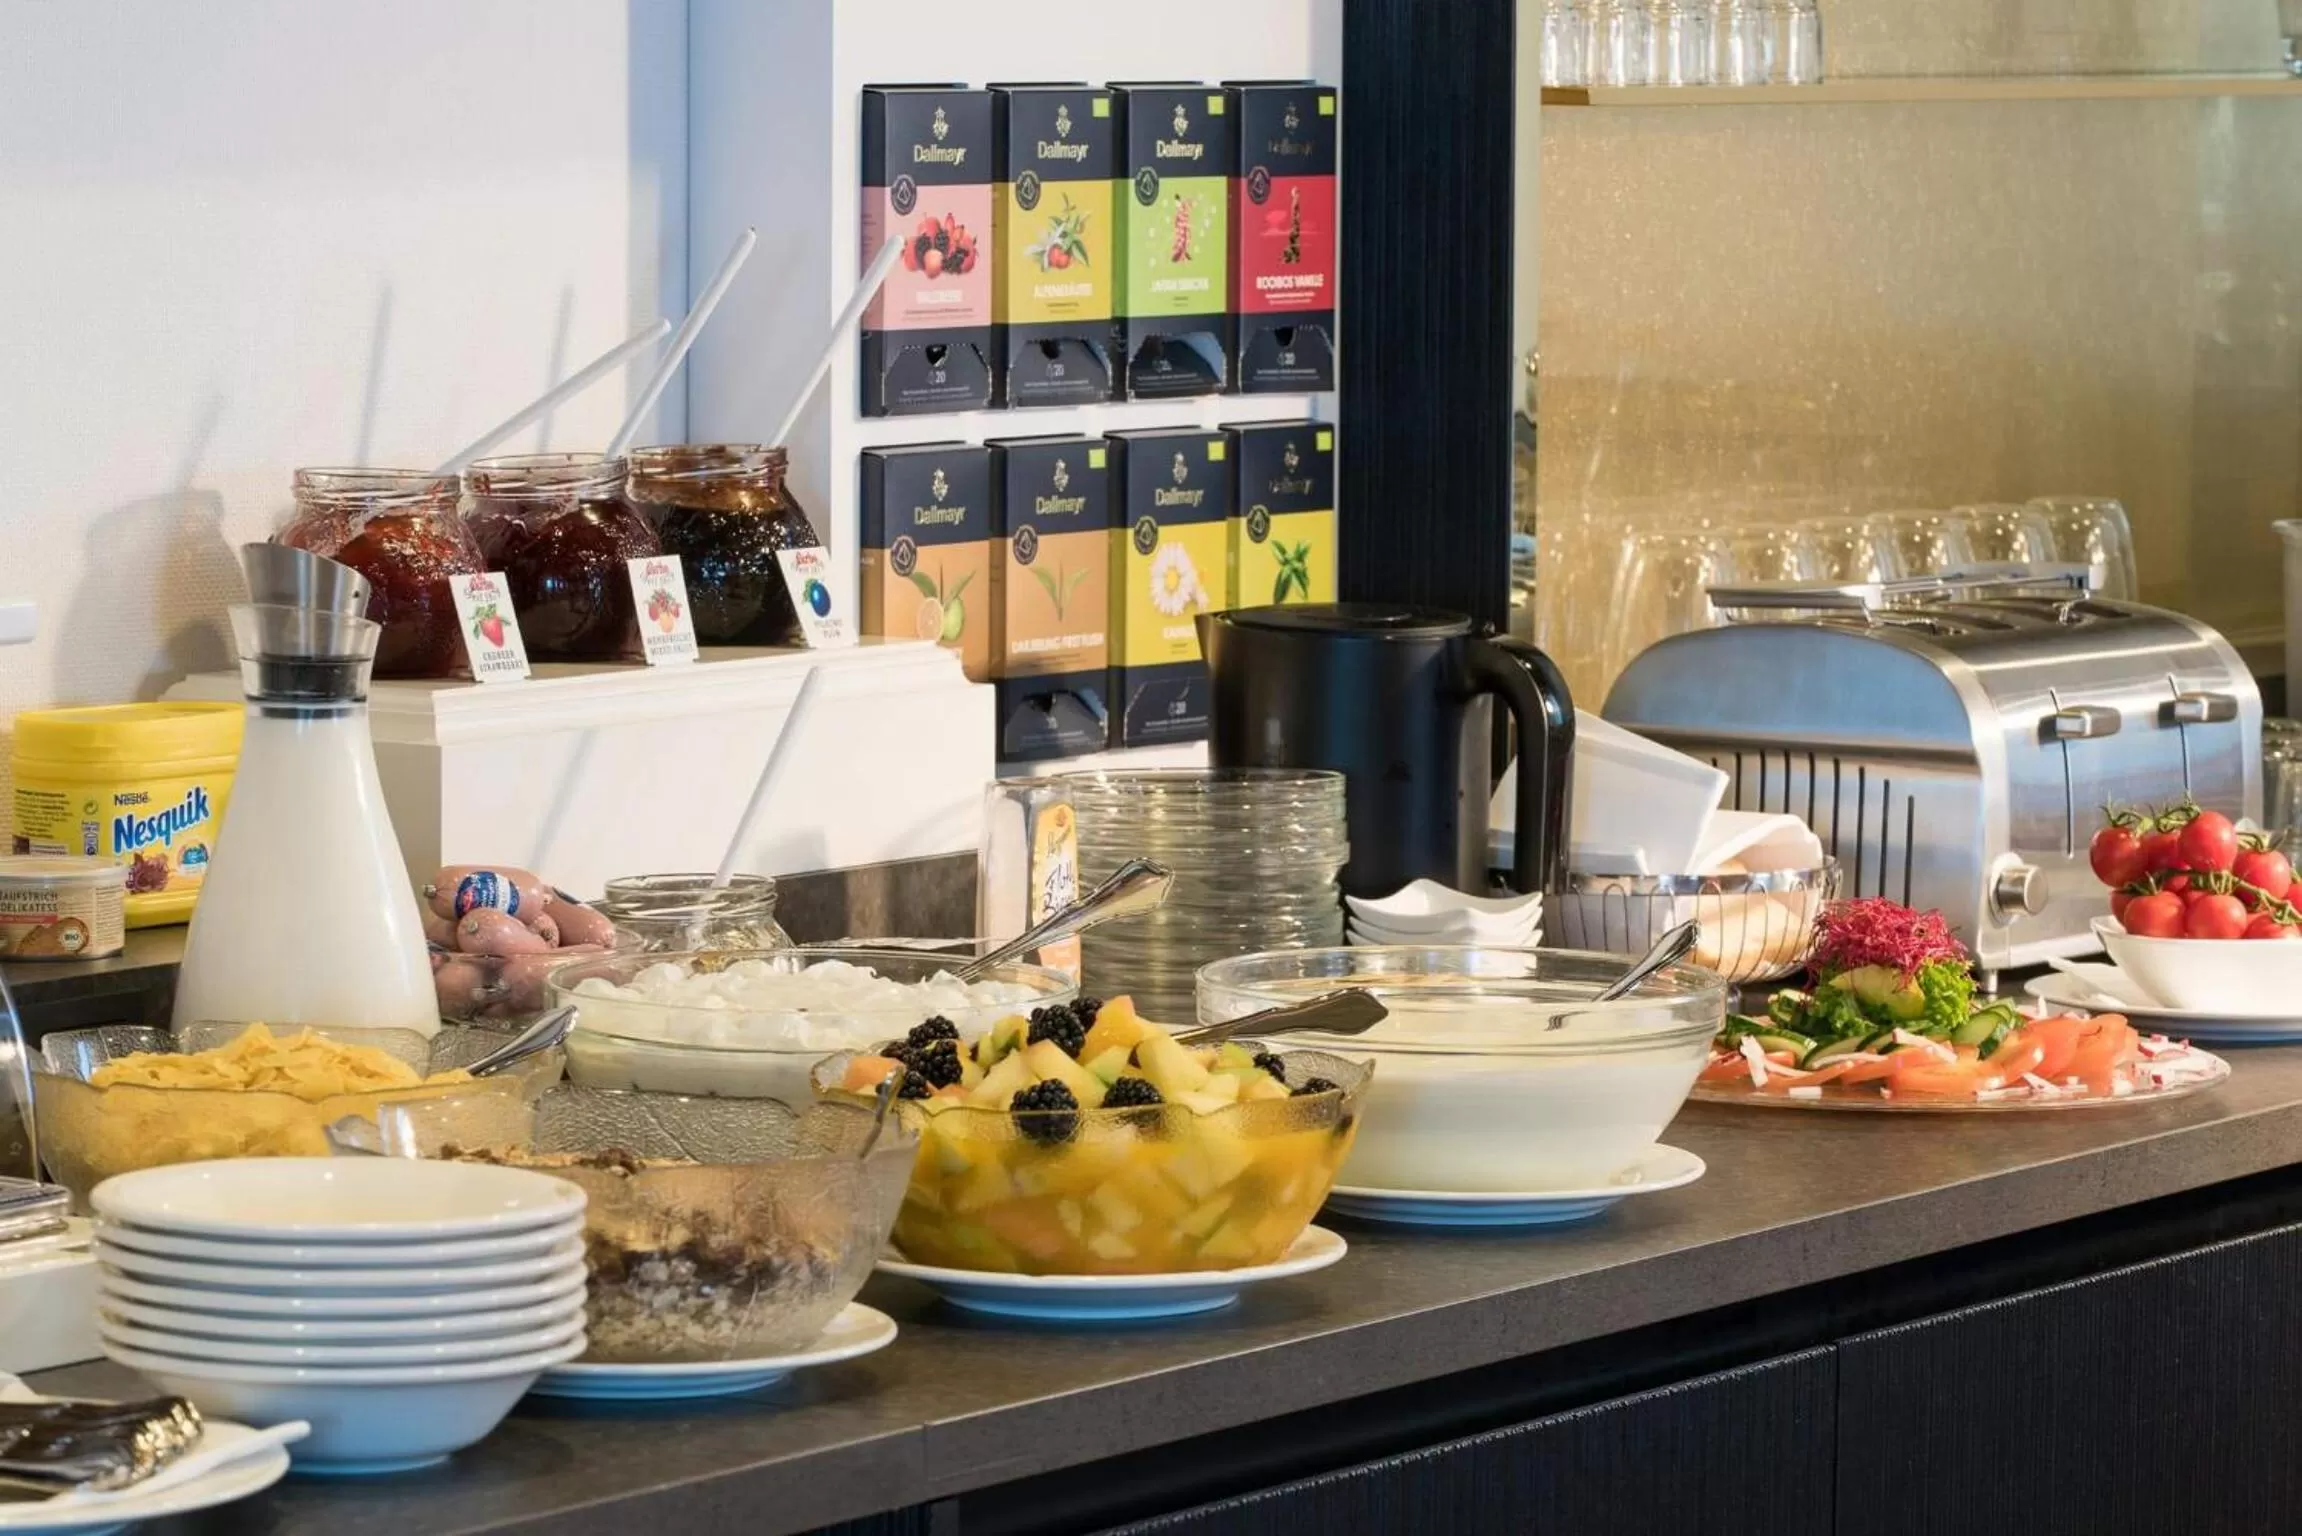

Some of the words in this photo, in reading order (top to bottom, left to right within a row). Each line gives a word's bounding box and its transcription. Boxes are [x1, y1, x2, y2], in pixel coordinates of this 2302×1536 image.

[913, 143, 967, 166] Dallmayr
[1037, 140, 1089, 163] Dallmayr
[1155, 138, 1204, 160] Dallmayr
[1036, 495, 1086, 516] Dallmayr
[1155, 486, 1204, 508] Dallmayr
[914, 503, 967, 526] Dallmayr
[114, 791, 150, 806] Nestlé
[113, 786, 209, 854] Nesquik
